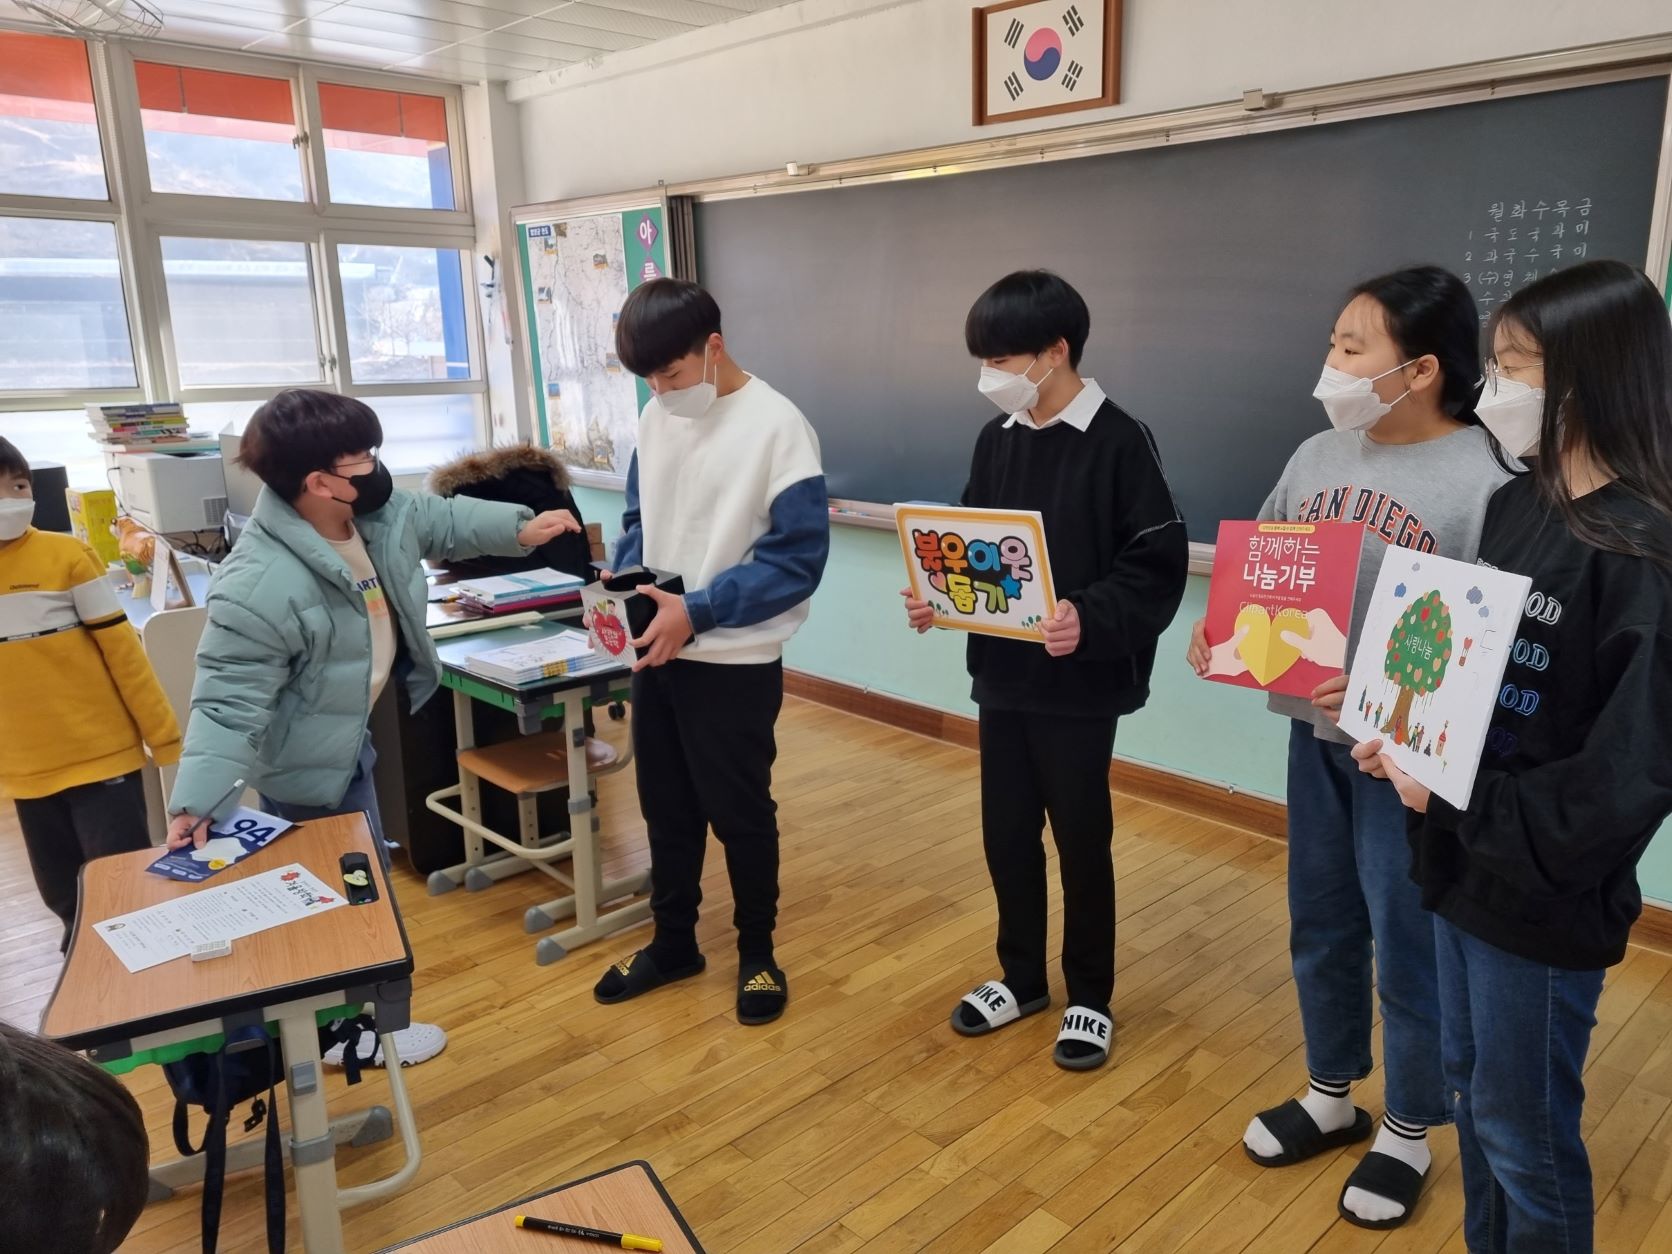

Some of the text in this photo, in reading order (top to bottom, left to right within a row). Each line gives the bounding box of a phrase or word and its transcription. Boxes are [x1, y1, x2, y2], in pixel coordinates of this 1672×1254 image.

[1488, 197, 1592, 223] 월 화 수 목 금
[1484, 226, 1500, 242] 국
[1507, 228, 1518, 241] 도
[1528, 227, 1540, 242] 국
[1552, 222, 1565, 239] 과
[1465, 251, 1473, 261] 2
[1482, 249, 1498, 263] 과
[1503, 247, 1516, 264] 국
[1524, 247, 1540, 263] 수
[1550, 243, 1563, 259] 국
[1463, 272, 1471, 284] 3
[1503, 269, 1514, 287] 영
[1478, 290, 1495, 305] 수
[1352, 486, 1439, 555] DIEGO
[1248, 535, 1320, 565] 함께하는
[1243, 563, 1317, 593] 나눔기부
[1404, 633, 1433, 661] 사랑나눔
[233, 819, 277, 843] 94
[743, 983, 782, 992] adidas
[1061, 1014, 1108, 1040] NIKE
